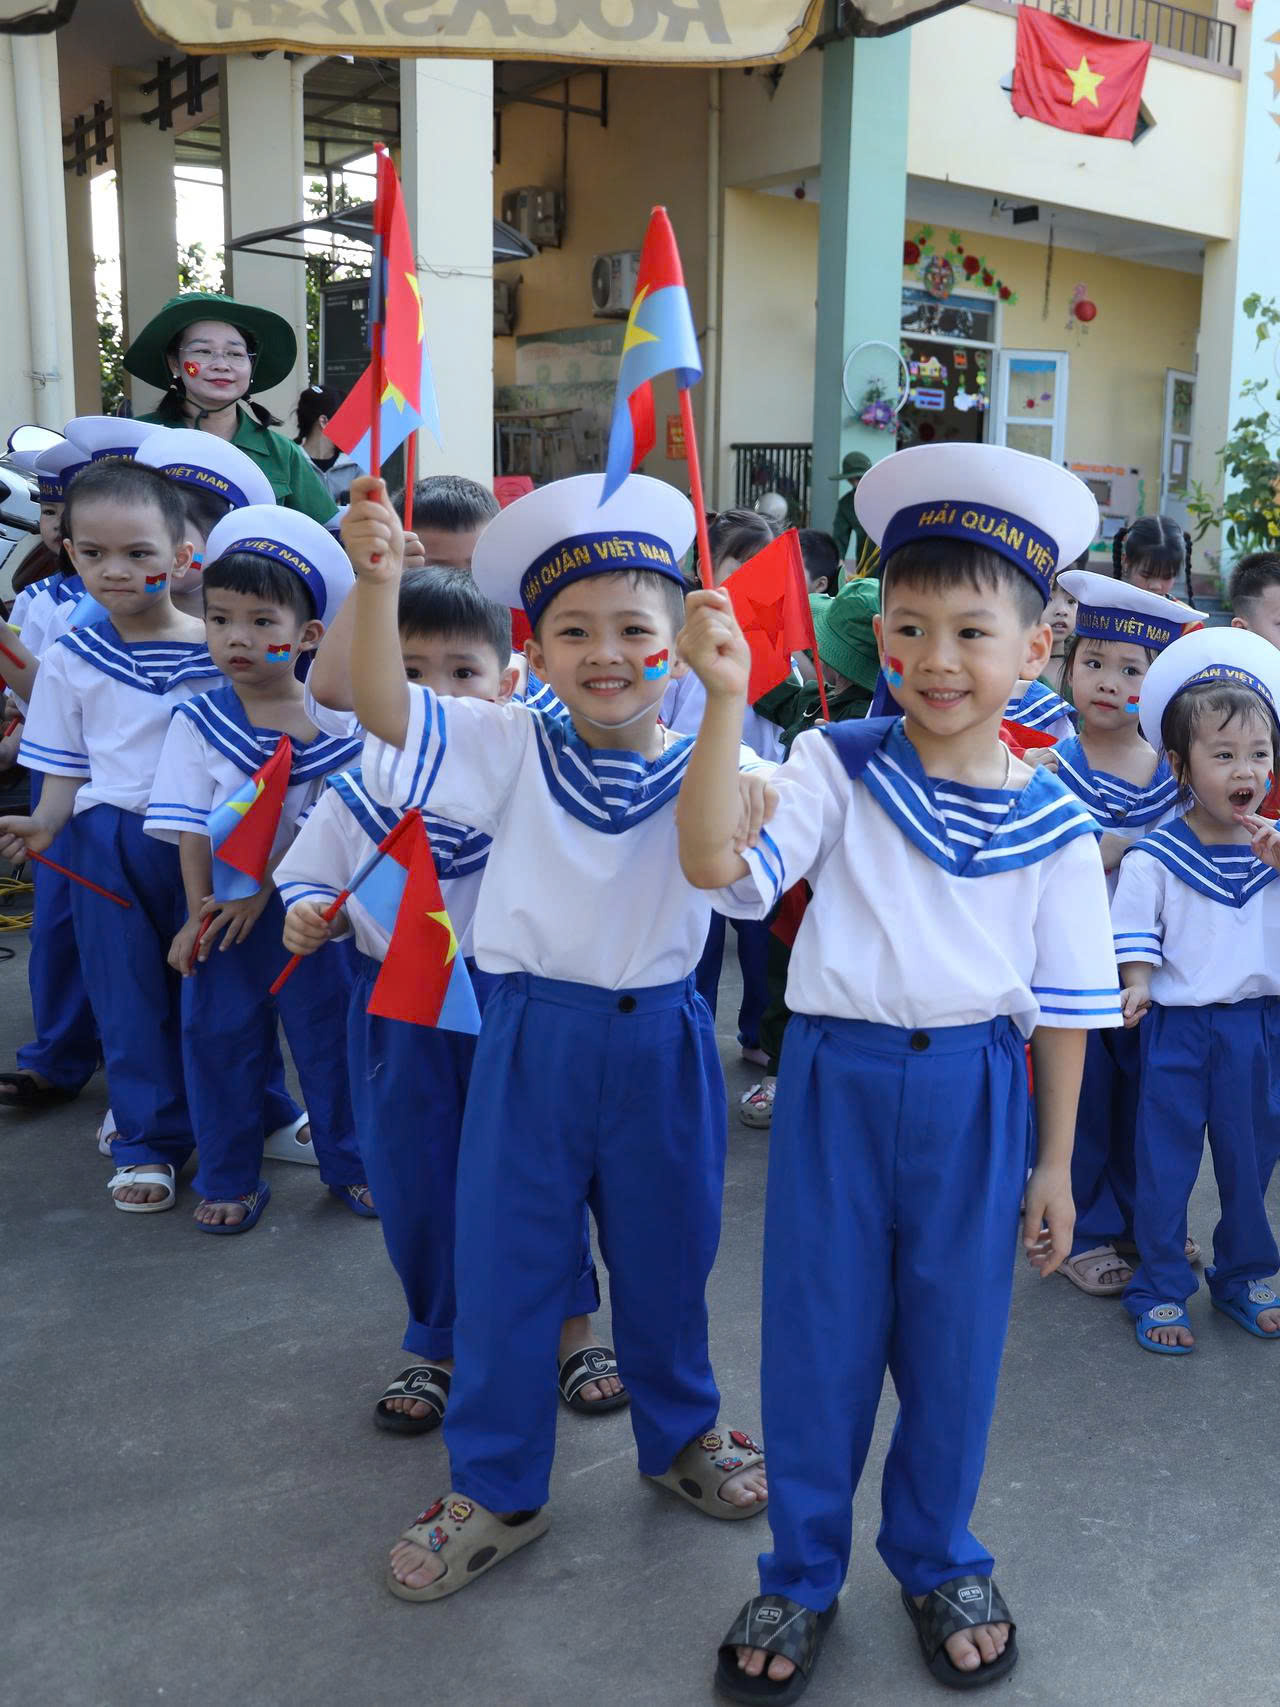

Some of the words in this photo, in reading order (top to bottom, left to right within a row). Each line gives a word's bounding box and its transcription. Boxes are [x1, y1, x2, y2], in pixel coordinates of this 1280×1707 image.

[196, 471, 229, 491] NAM
[919, 503, 956, 527] HẢI
[961, 511, 1024, 550] QUÂN
[279, 549, 311, 575] NAM
[541, 545, 592, 585] QUÂN
[593, 537, 636, 561] VIỆT
[638, 542, 672, 565] NAM
[1114, 617, 1144, 637] VIỆT
[1146, 624, 1170, 643] NAM
